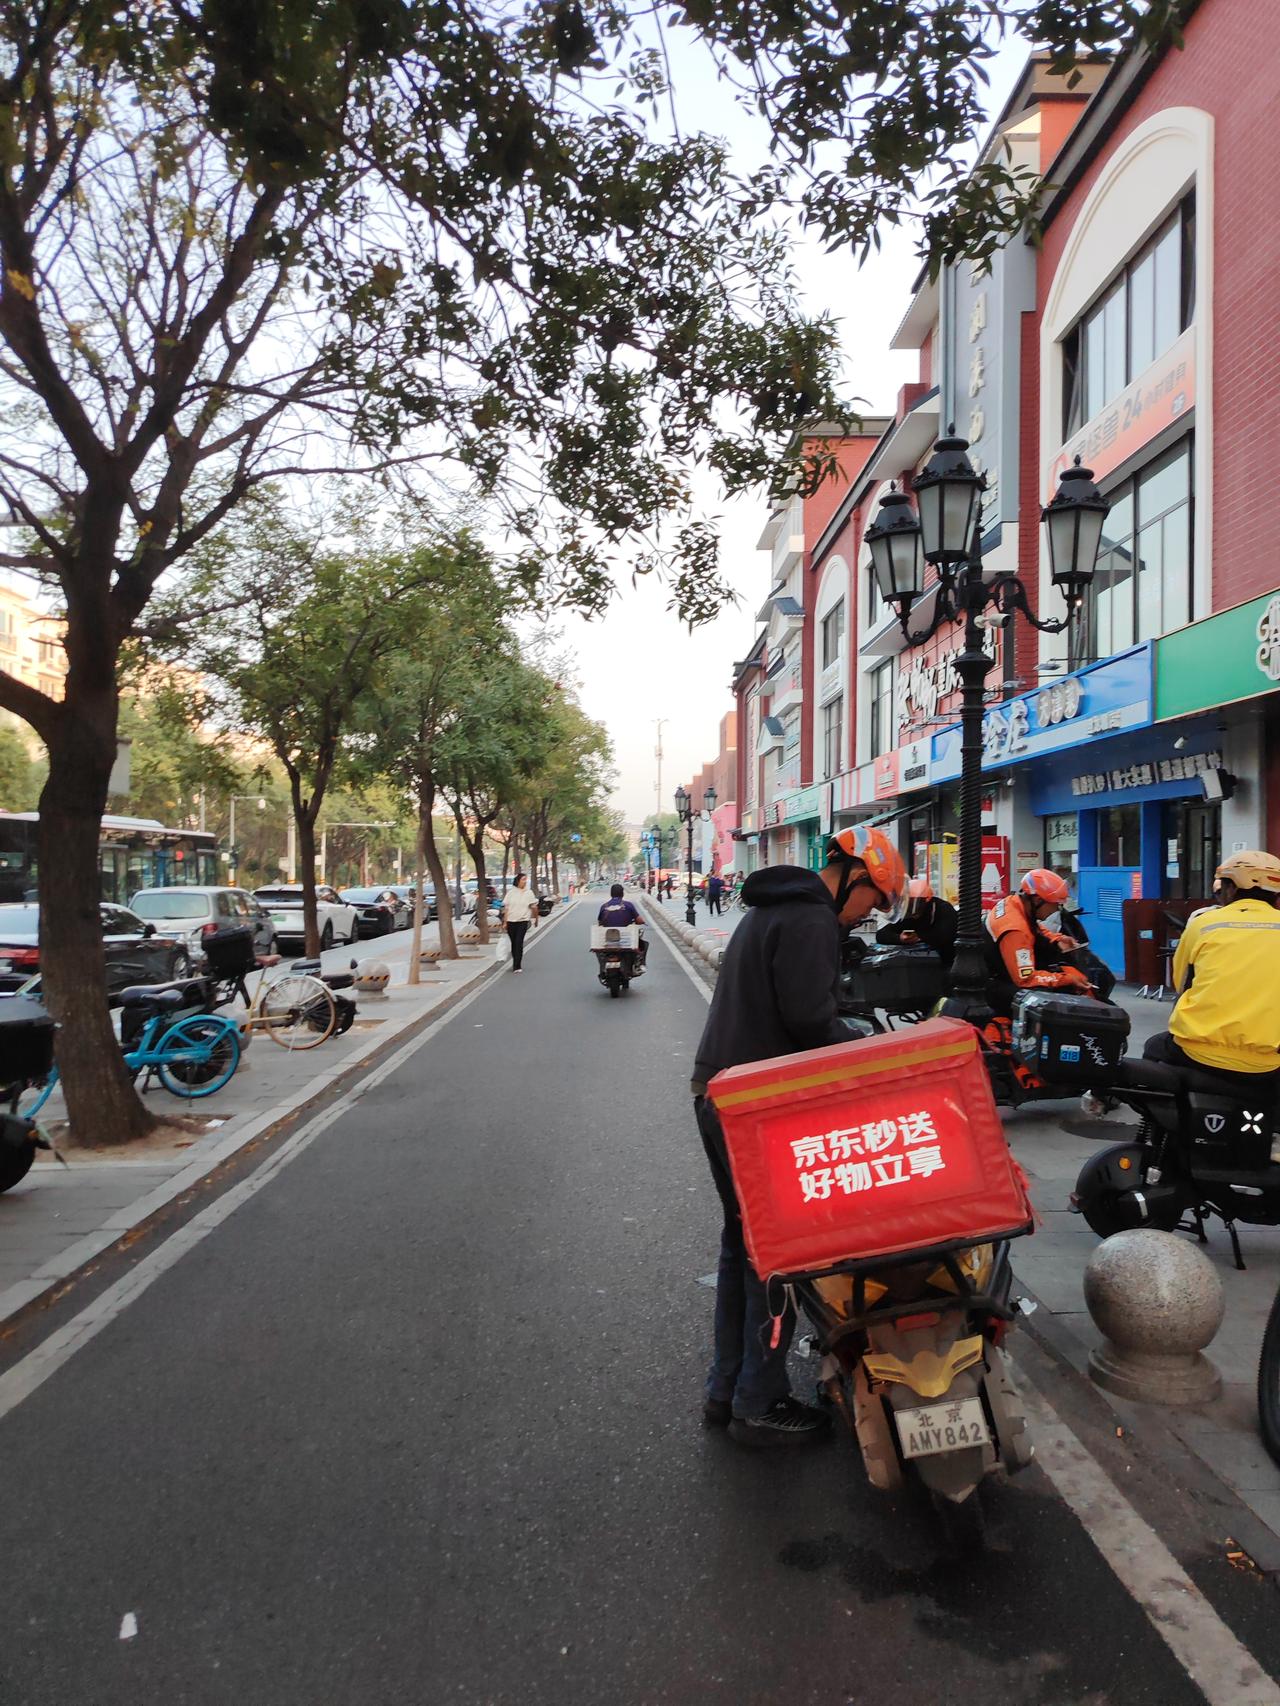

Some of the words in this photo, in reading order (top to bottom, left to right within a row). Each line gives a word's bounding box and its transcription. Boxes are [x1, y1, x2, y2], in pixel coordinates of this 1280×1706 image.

[790, 1111, 938, 1168] 京东秒送
[799, 1145, 946, 1203] 好物立享
[909, 1422, 982, 1452] AMY842
